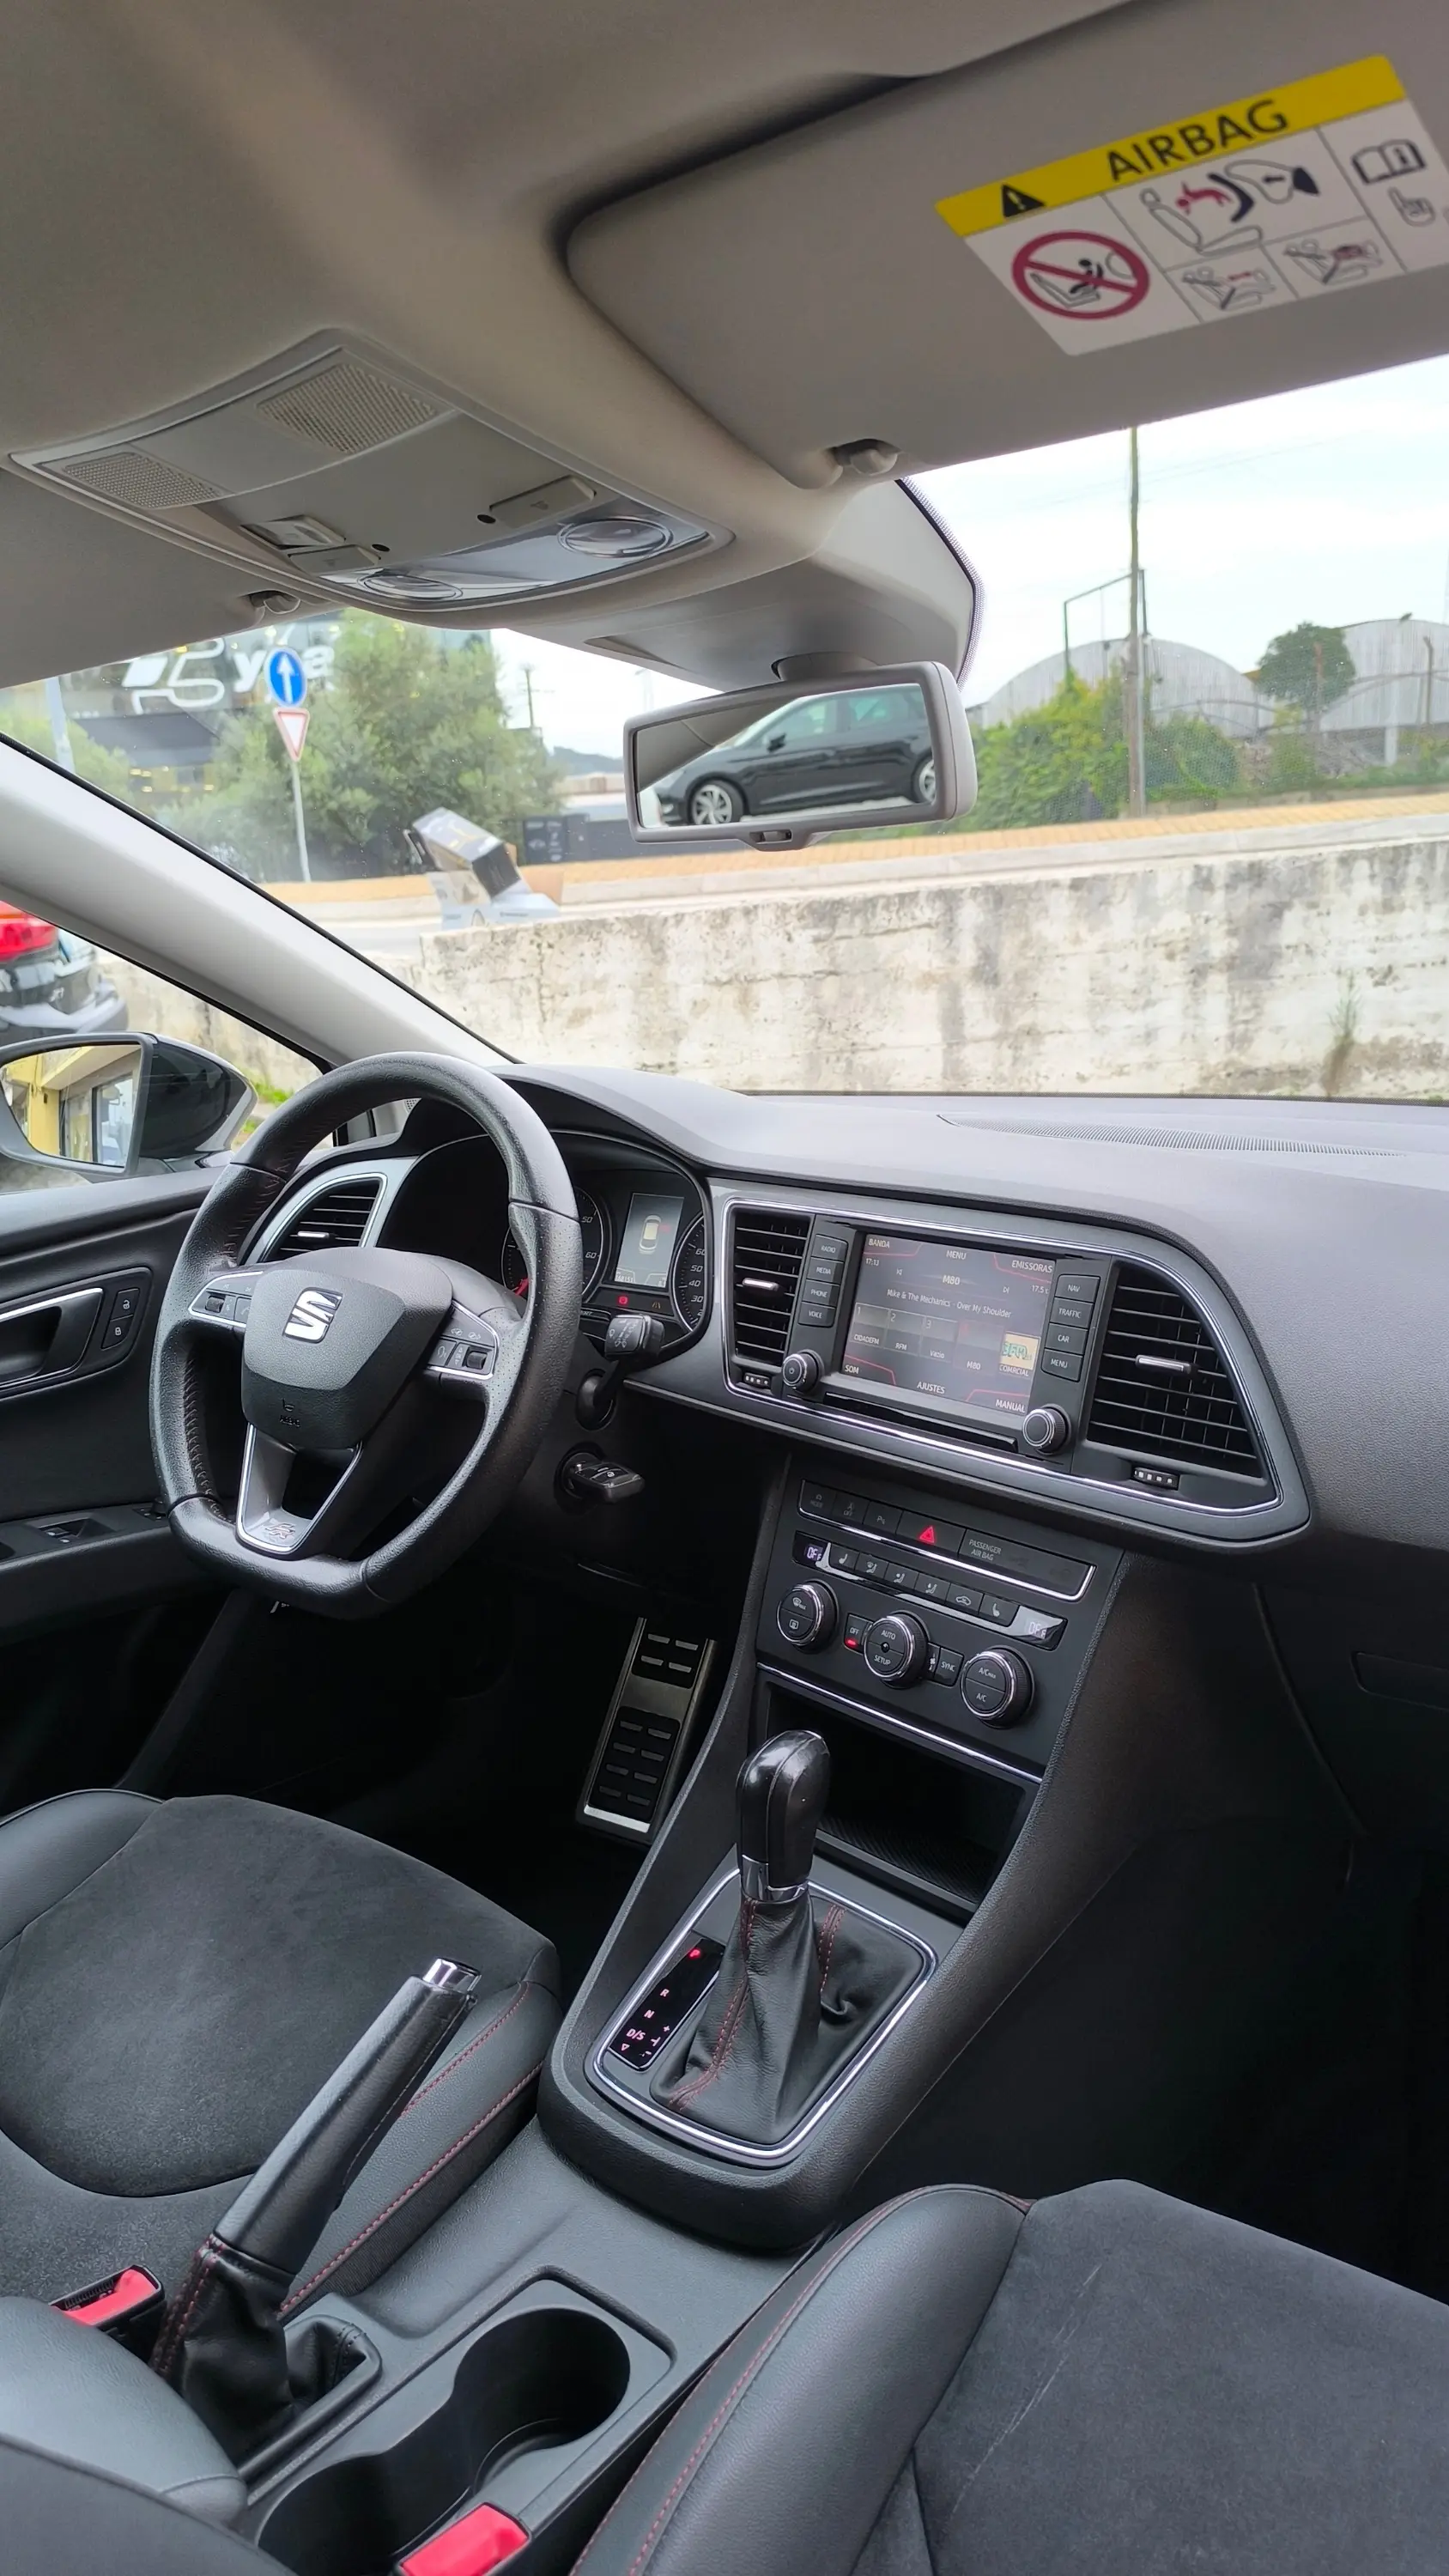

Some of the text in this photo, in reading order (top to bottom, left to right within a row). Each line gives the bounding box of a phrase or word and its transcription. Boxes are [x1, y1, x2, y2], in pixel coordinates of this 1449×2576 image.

[1106, 99, 1288, 182] AIRBAG
[869, 1238, 890, 1249] BANDA
[821, 1245, 836, 1254] RADIO
[946, 1250, 967, 1260] MENU
[816, 1267, 832, 1275] MEDIA
[1011, 1260, 1053, 1273] EMISSORAS
[943, 1274, 961, 1285] M80
[810, 1289, 828, 1298] PHONE
[1067, 1284, 1080, 1292] NAV
[887, 1289, 900, 1298] Mike
[908, 1292, 919, 1302] The
[920, 1295, 950, 1307] Mechanics
[956, 1302, 972, 1311] Over
[973, 1304, 981, 1313] My
[983, 1306, 1011, 1318] Shoulder
[809, 1309, 822, 1319] VOICE
[890, 1312, 896, 1322] 2
[1058, 1308, 1082, 1319] TRAFFIC
[1058, 1334, 1070, 1343] CAR
[895, 1342, 907, 1351] RFM
[845, 1364, 859, 1374] SOM
[967, 1360, 981, 1370] M80
[1051, 1358, 1068, 1369] MENU
[917, 1381, 945, 1394] AJUSTES
[996, 1399, 1026, 1413] MANUAL
[969, 1539, 1002, 1555] PASSENGER
[807, 1546, 822, 1561] OFF
[971, 1548, 994, 1561] AIR BAG
[849, 1626, 859, 1635] OFF
[881, 1630, 896, 1640] AUTO
[874, 1655, 891, 1666] SETUP
[941, 1662, 956, 1673] SYNC
[976, 1692, 987, 1703] A/C
[689, 1948, 701, 1959] P
[659, 1988, 670, 1997] R
[644, 2009, 655, 2019] N
[626, 2028, 646, 2041] D/S
